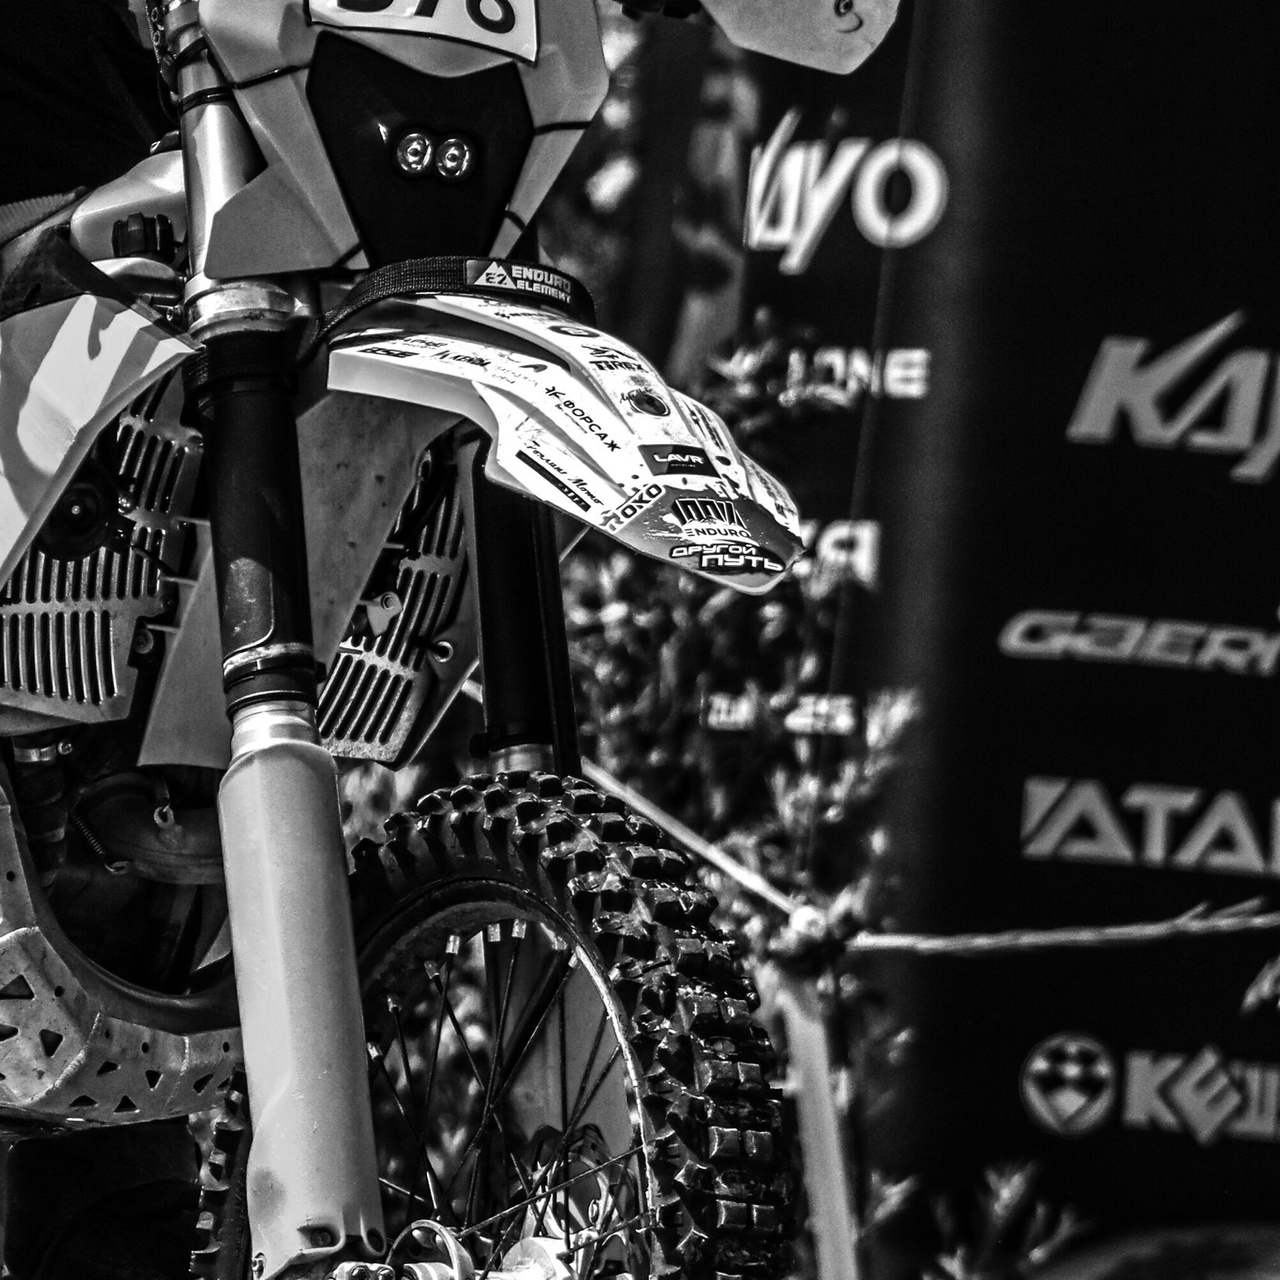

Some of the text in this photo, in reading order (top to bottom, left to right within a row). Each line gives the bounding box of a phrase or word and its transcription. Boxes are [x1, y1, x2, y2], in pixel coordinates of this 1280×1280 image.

[511, 265, 571, 293] ENDURO
[516, 280, 572, 304] ELEMENT
[562, 399, 622, 452] ФОРСАЖ
[652, 453, 705, 465] LAVR
[684, 528, 751, 538] ENDURO
[671, 544, 757, 558] ДРУГОЙ
[701, 554, 784, 572] ПУТЬ
[1021, 776, 1280, 878] ATA
